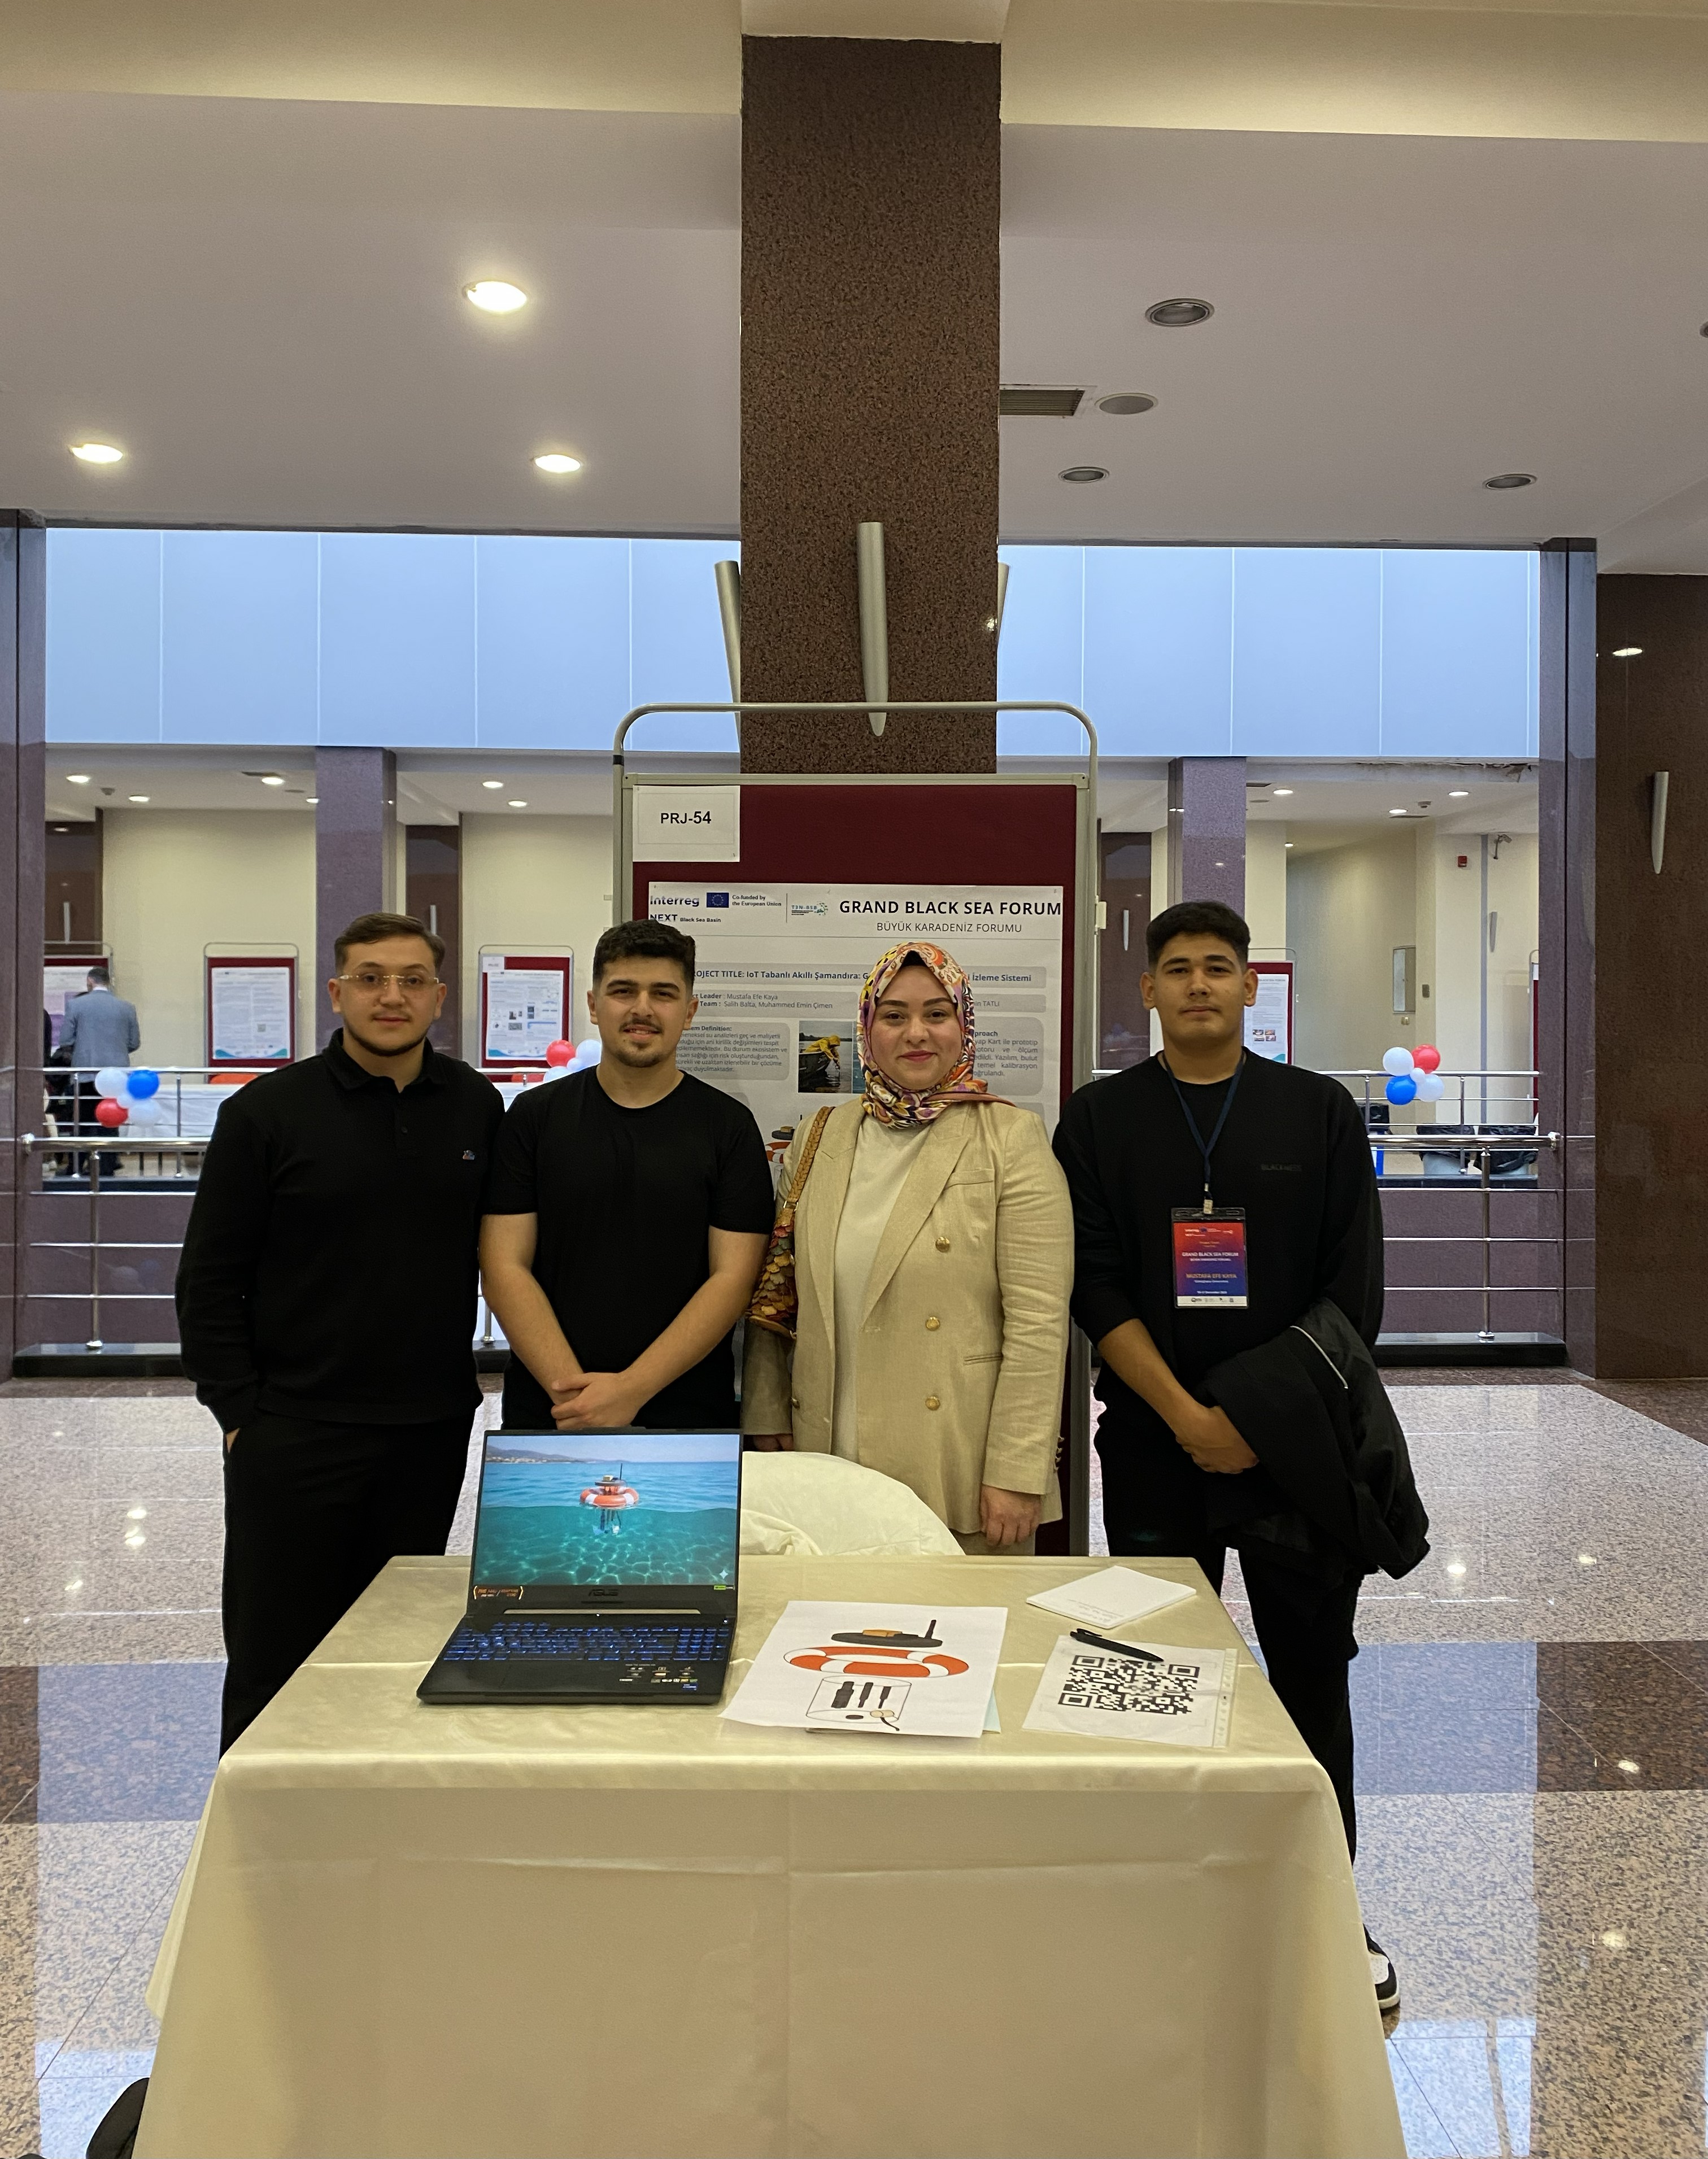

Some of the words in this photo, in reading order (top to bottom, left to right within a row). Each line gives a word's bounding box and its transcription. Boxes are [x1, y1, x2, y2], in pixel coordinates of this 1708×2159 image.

[661, 811, 712, 824] PRJ-54
[650, 895, 700, 907] Interreg
[839, 900, 899, 913] GRAND
[905, 901, 958, 914] BLACK
[964, 902, 994, 914] SEA
[1000, 902, 1061, 915] FORUM
[650, 914, 677, 922] NEXT
[877, 921, 912, 931] BÜYÜK
[915, 922, 973, 932] KARADENİZ
[976, 923, 1022, 932] FORUMU
[814, 972, 861, 980] Şamandıra:
[973, 972, 999, 981] İzleme
